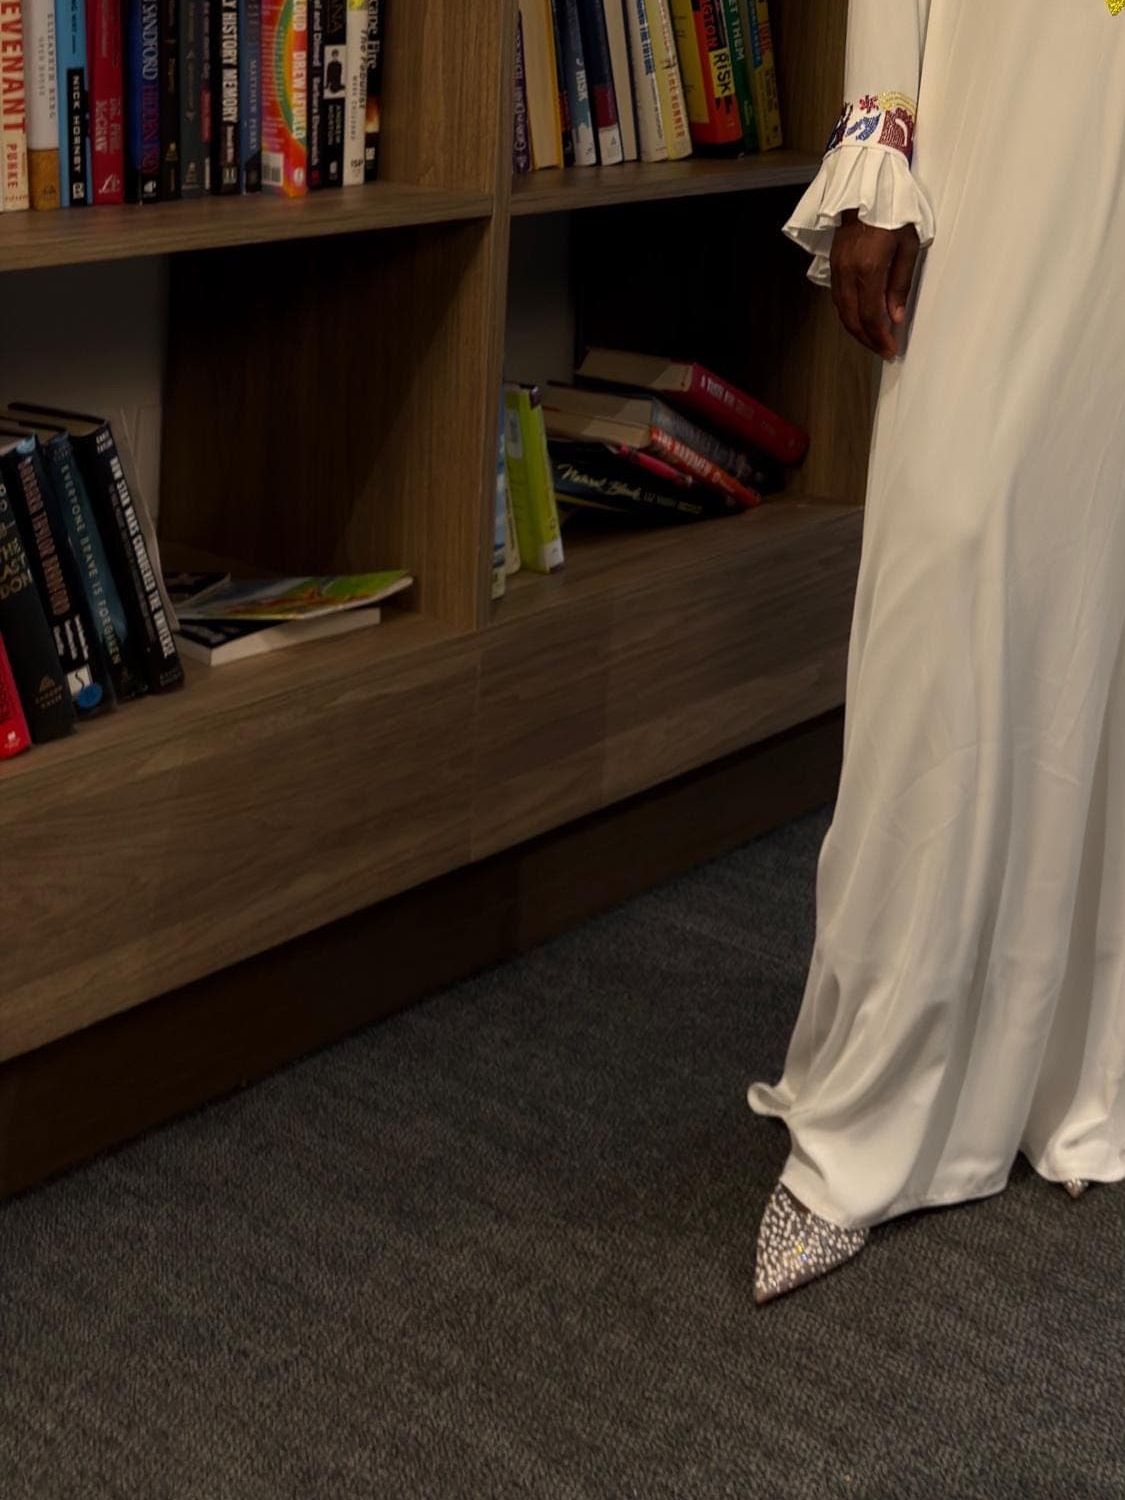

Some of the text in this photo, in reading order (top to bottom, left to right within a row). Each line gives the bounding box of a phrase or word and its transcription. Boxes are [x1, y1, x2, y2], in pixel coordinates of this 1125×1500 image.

[141, 4, 159, 81] SANDFORD
[221, 11, 238, 65] HISTORY
[367, 40, 380, 71] Fire
[731, 20, 745, 61] THEM
[221, 68, 239, 122] MEMORY
[575, 70, 588, 101] RISK
[714, 53, 731, 94] RISK
[72, 75, 82, 172] NICK HORNBY
[671, 90, 686, 139] RUNNER
[6, 142, 18, 188] PUNKE
[61, 464, 122, 666] EVERYONE BRAVE IS FORGIVEN
